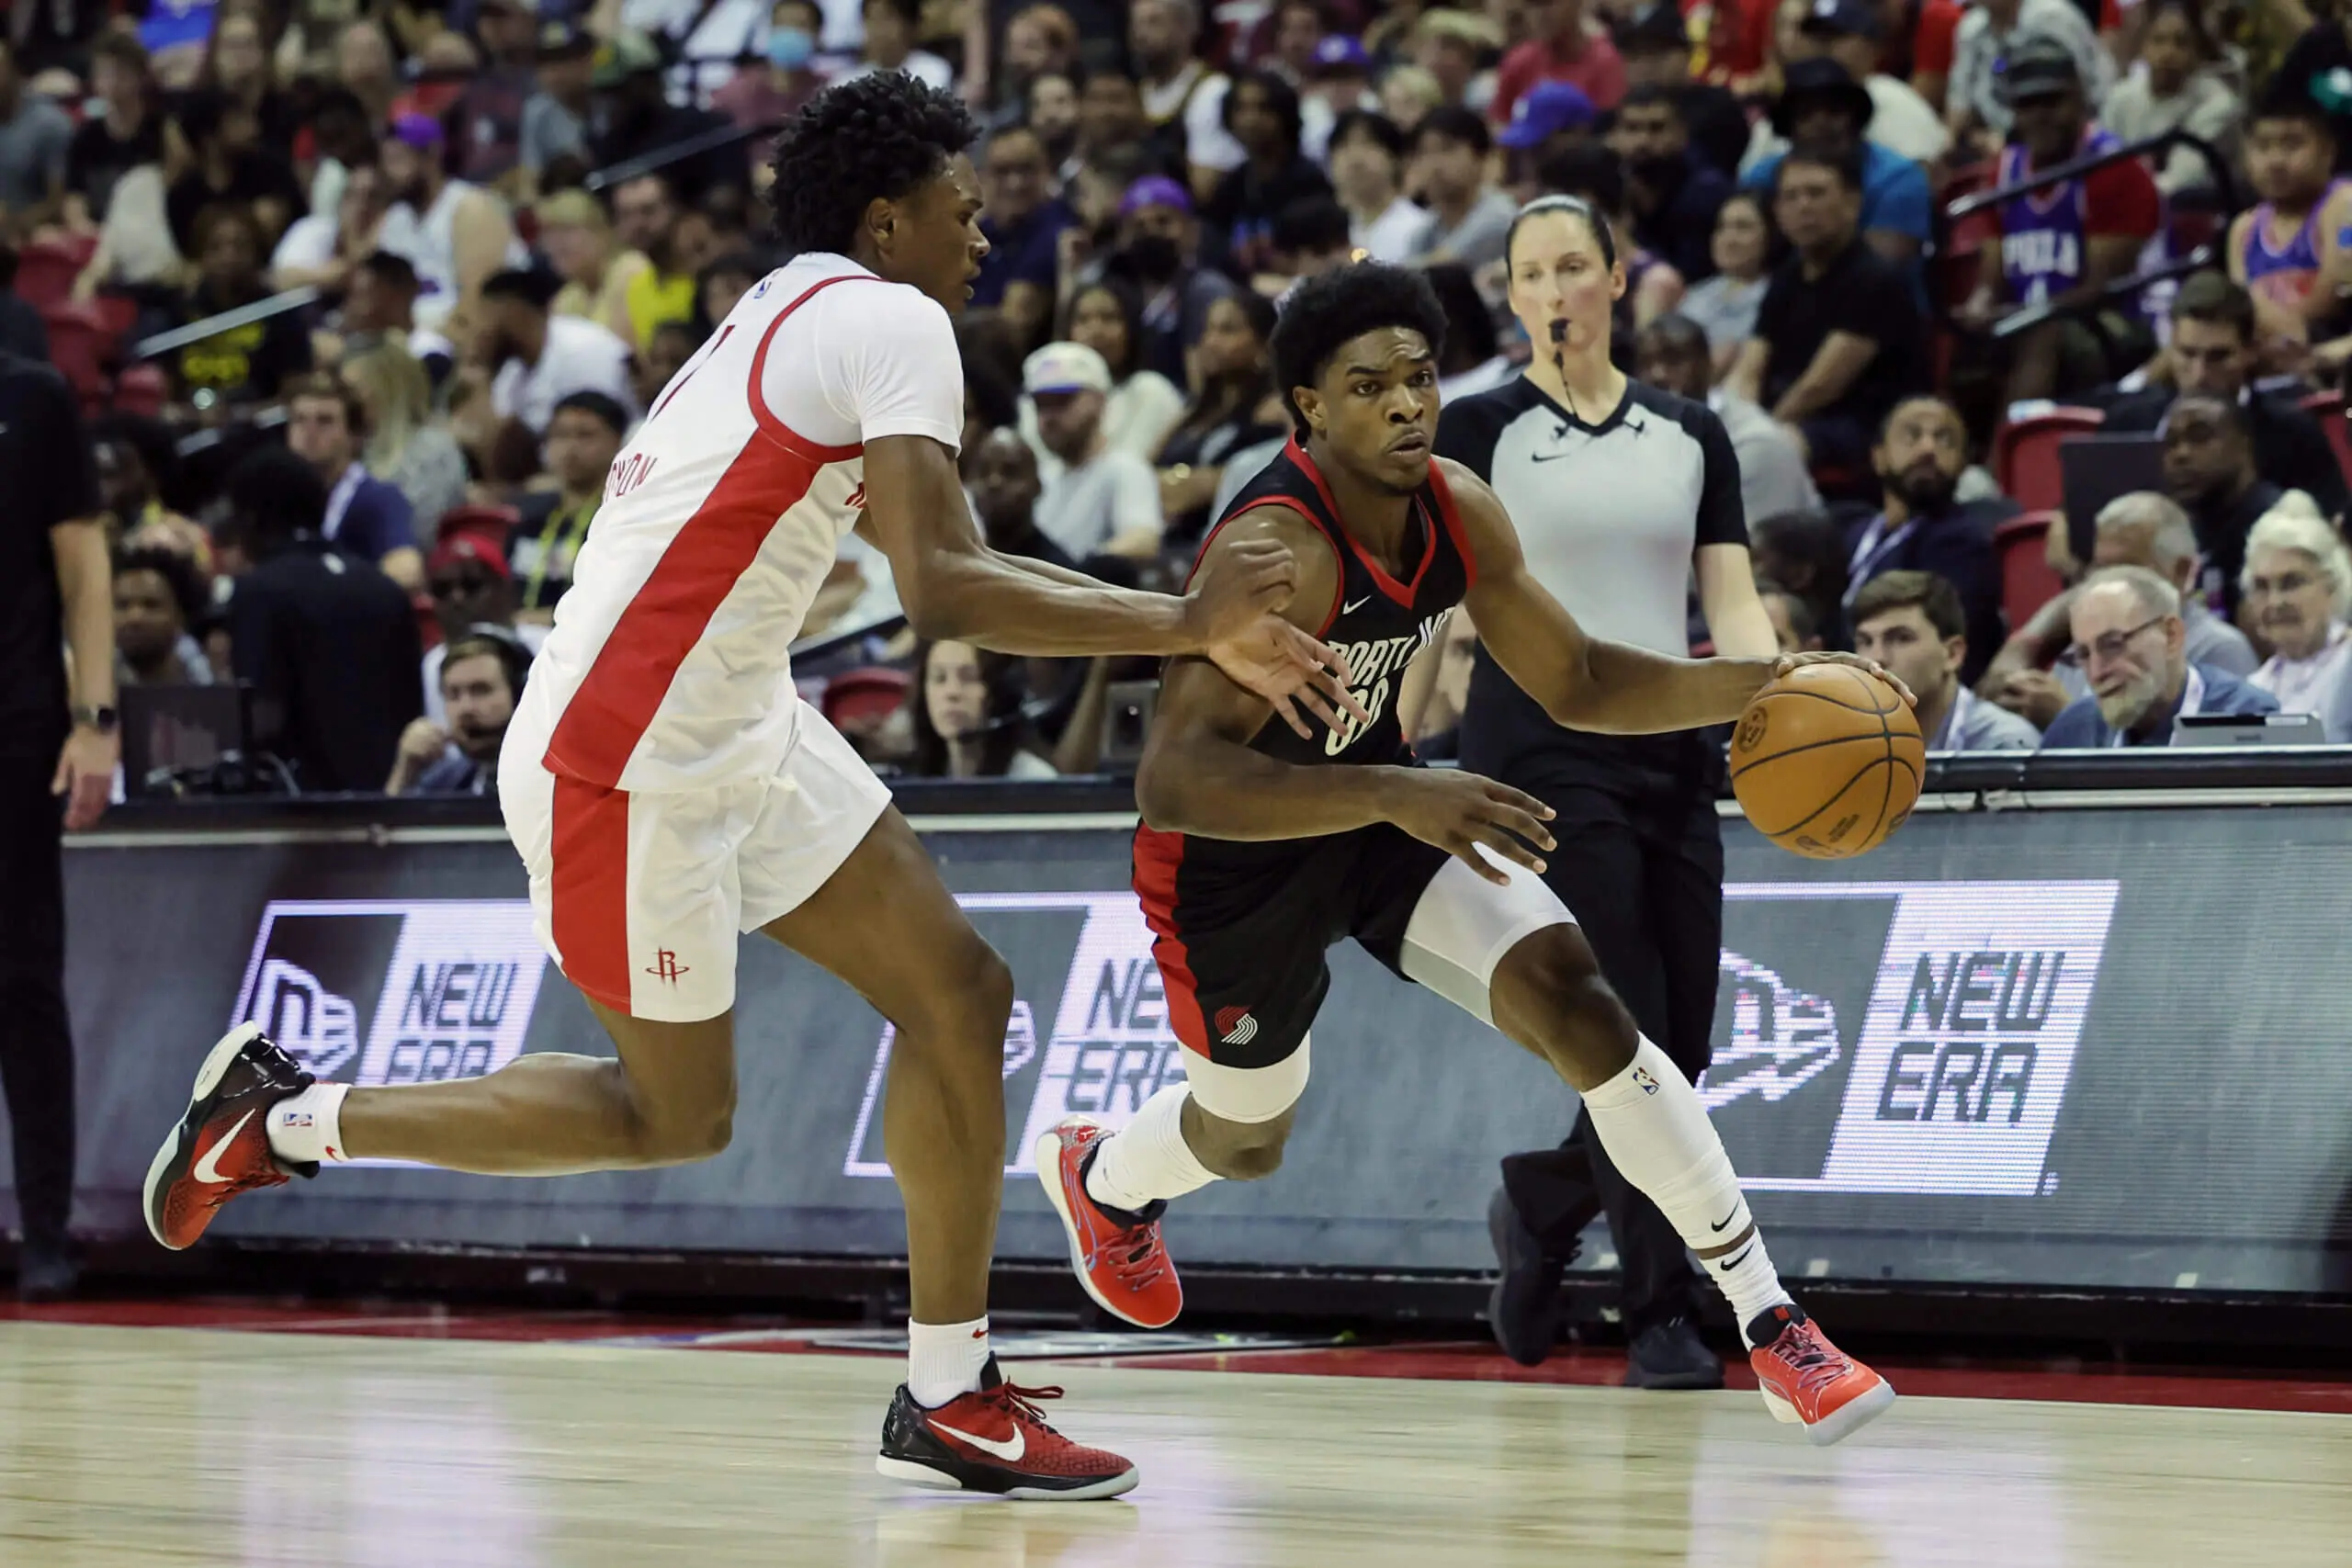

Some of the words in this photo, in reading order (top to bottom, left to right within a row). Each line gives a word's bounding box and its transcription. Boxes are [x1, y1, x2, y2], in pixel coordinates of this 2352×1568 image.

[401, 963, 517, 1028] NEW
[1086, 958, 1170, 1029] NE
[1900, 951, 2066, 1031] NEW
[1875, 1042, 2038, 1122] ERA
